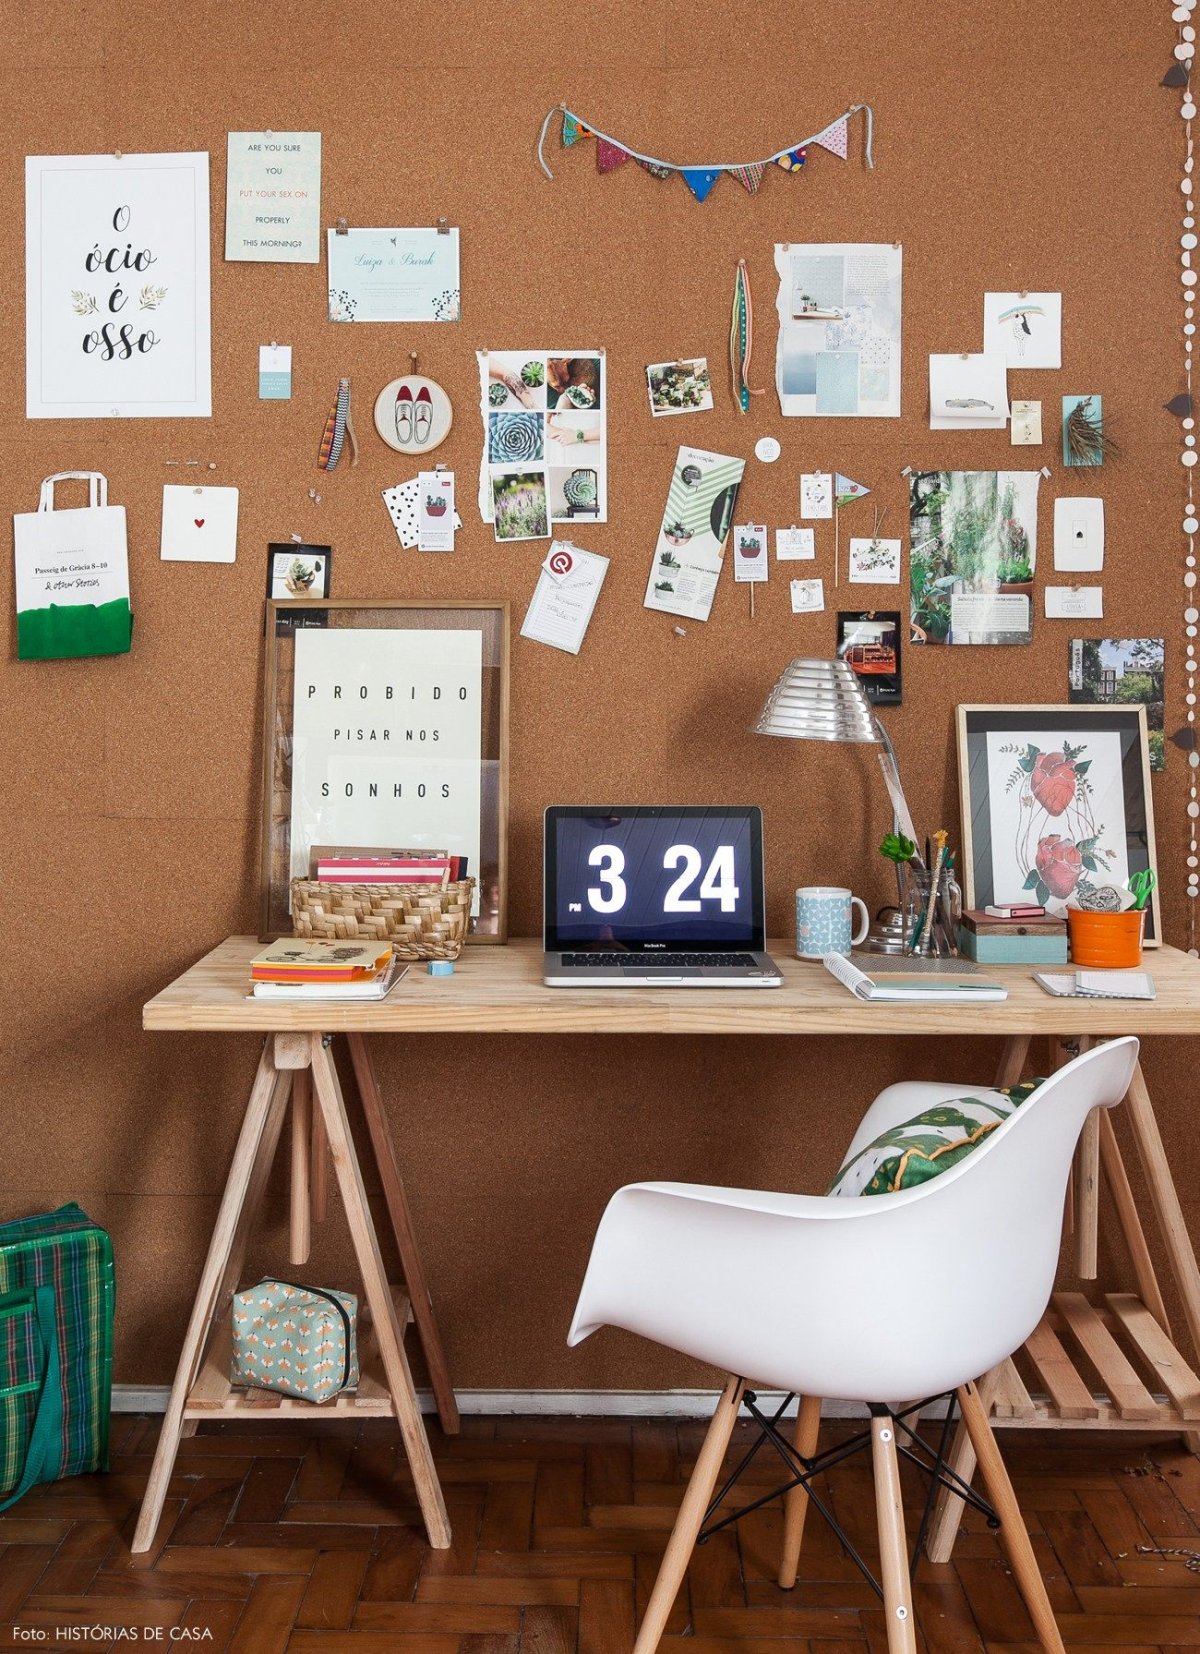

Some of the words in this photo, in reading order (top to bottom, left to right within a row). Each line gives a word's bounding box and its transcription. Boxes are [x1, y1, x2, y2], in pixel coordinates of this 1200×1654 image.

[247, 144, 262, 152] ARE
[264, 144, 282, 152] YOU
[284, 144, 301, 152] SURE
[265, 167, 283, 175] YOU
[239, 190, 253, 198] PUT
[255, 190, 276, 198] YOUR
[278, 190, 292, 198] SEX
[294, 190, 308, 198] ON
[112, 204, 131, 233] O
[255, 216, 291, 224] PROPERLY
[242, 239, 258, 247] THIS
[260, 239, 302, 248] MORNING?
[84, 242, 158, 274] ócio
[354, 252, 383, 272] Luiza
[400, 250, 436, 266] Burak
[108, 281, 129, 314] é
[81, 322, 161, 362] osso
[35, 566, 59, 575] Passeig
[60, 565, 68, 573] de
[75, 578, 100, 589] Stories
[308, 685, 468, 700] PROBIDO
[333, 729, 391, 741] PISAR
[406, 729, 440, 741] NOS
[321, 782, 451, 798] SONHOS
[568, 902, 582, 912] PM
[587, 844, 627, 914] 3
[663, 844, 740, 913] 24
